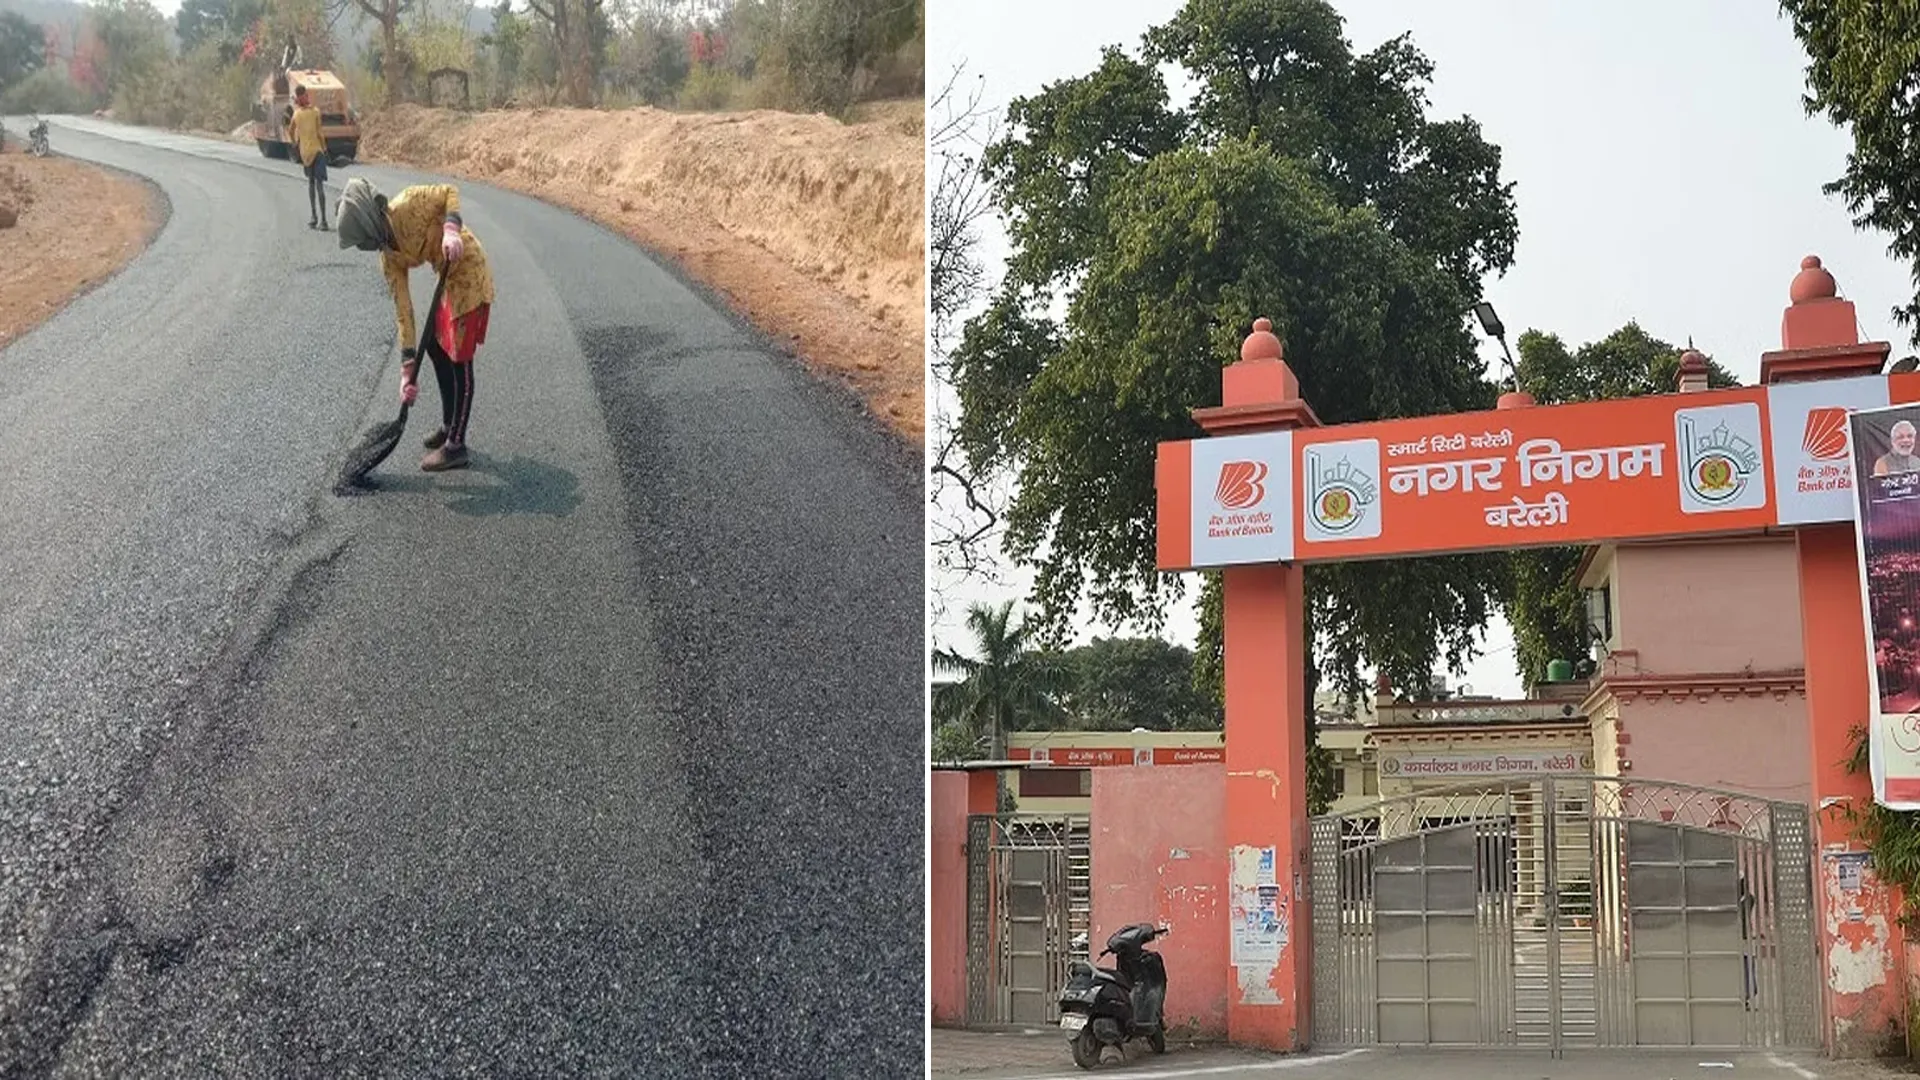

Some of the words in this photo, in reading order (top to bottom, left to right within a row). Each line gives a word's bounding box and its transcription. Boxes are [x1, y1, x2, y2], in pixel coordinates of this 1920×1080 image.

[1387, 436, 1427, 456] स्मार्ट
[1430, 433, 1466, 452] सिटी
[1470, 428, 1513, 448] बरेली
[1387, 457, 1507, 496] नगर
[1516, 438, 1666, 487] निगम
[1798, 479, 1824, 492] Bank
[1825, 479, 1836, 490] of
[1837, 477, 1852, 489] Ba
[1484, 492, 1569, 527] बरेली
[1403, 758, 1458, 774] कार्यालय
[1542, 754, 1576, 770] बरेली
